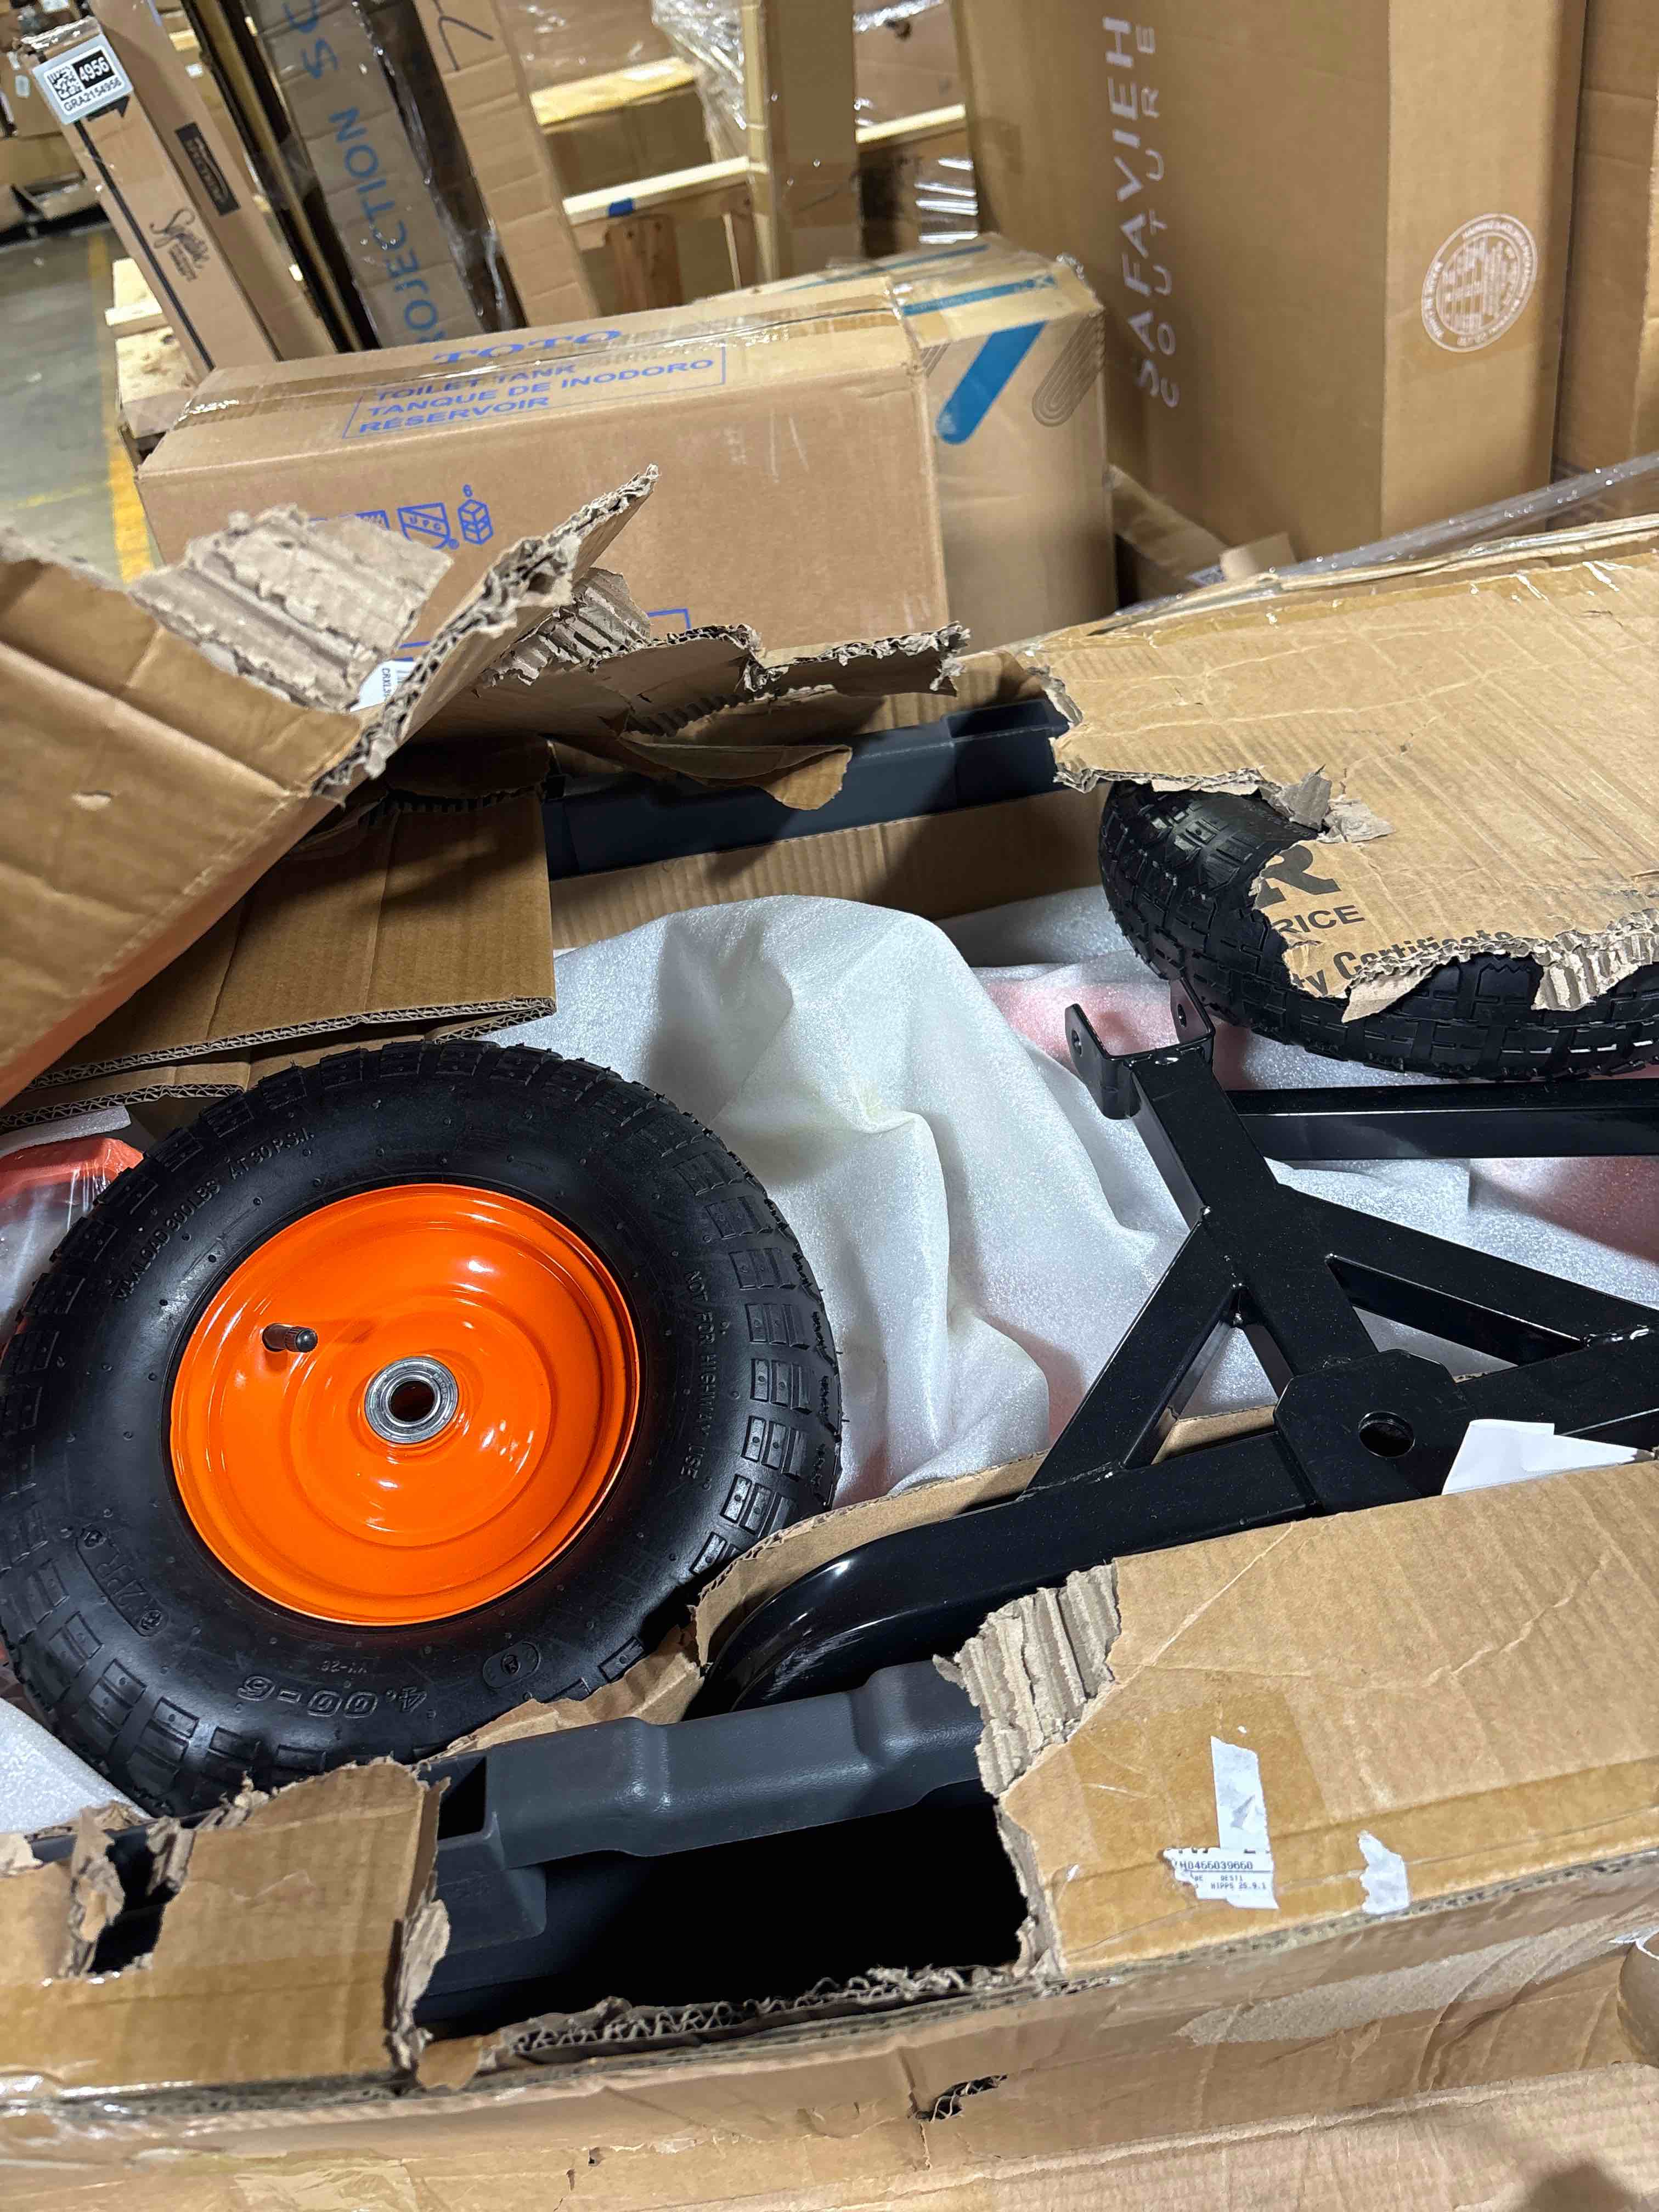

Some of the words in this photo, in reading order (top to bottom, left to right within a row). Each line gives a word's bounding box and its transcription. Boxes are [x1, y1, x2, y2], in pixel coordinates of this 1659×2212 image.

[79, 57, 110, 82] 4956
[64, 77, 122, 111] GRA2154956
[1102, 16, 1159, 397] SAFAVIEH
[1136, 24, 1180, 408] COUTURE
[432, 330, 622, 363] TOTO
[369, 389, 499, 416] TANQUE
[508, 382, 551, 397] DE
[561, 359, 714, 389] INODORO
[377, 377, 484, 401] TOILET
[494, 364, 575, 383] TANK
[1272, 905, 1365, 934] RICE
[686, 1271, 708, 1302] NOT
[695, 1312, 715, 1346] FOR
[680, 1443, 706, 1480] USE
[236, 1675, 427, 1719] 4.00-6
